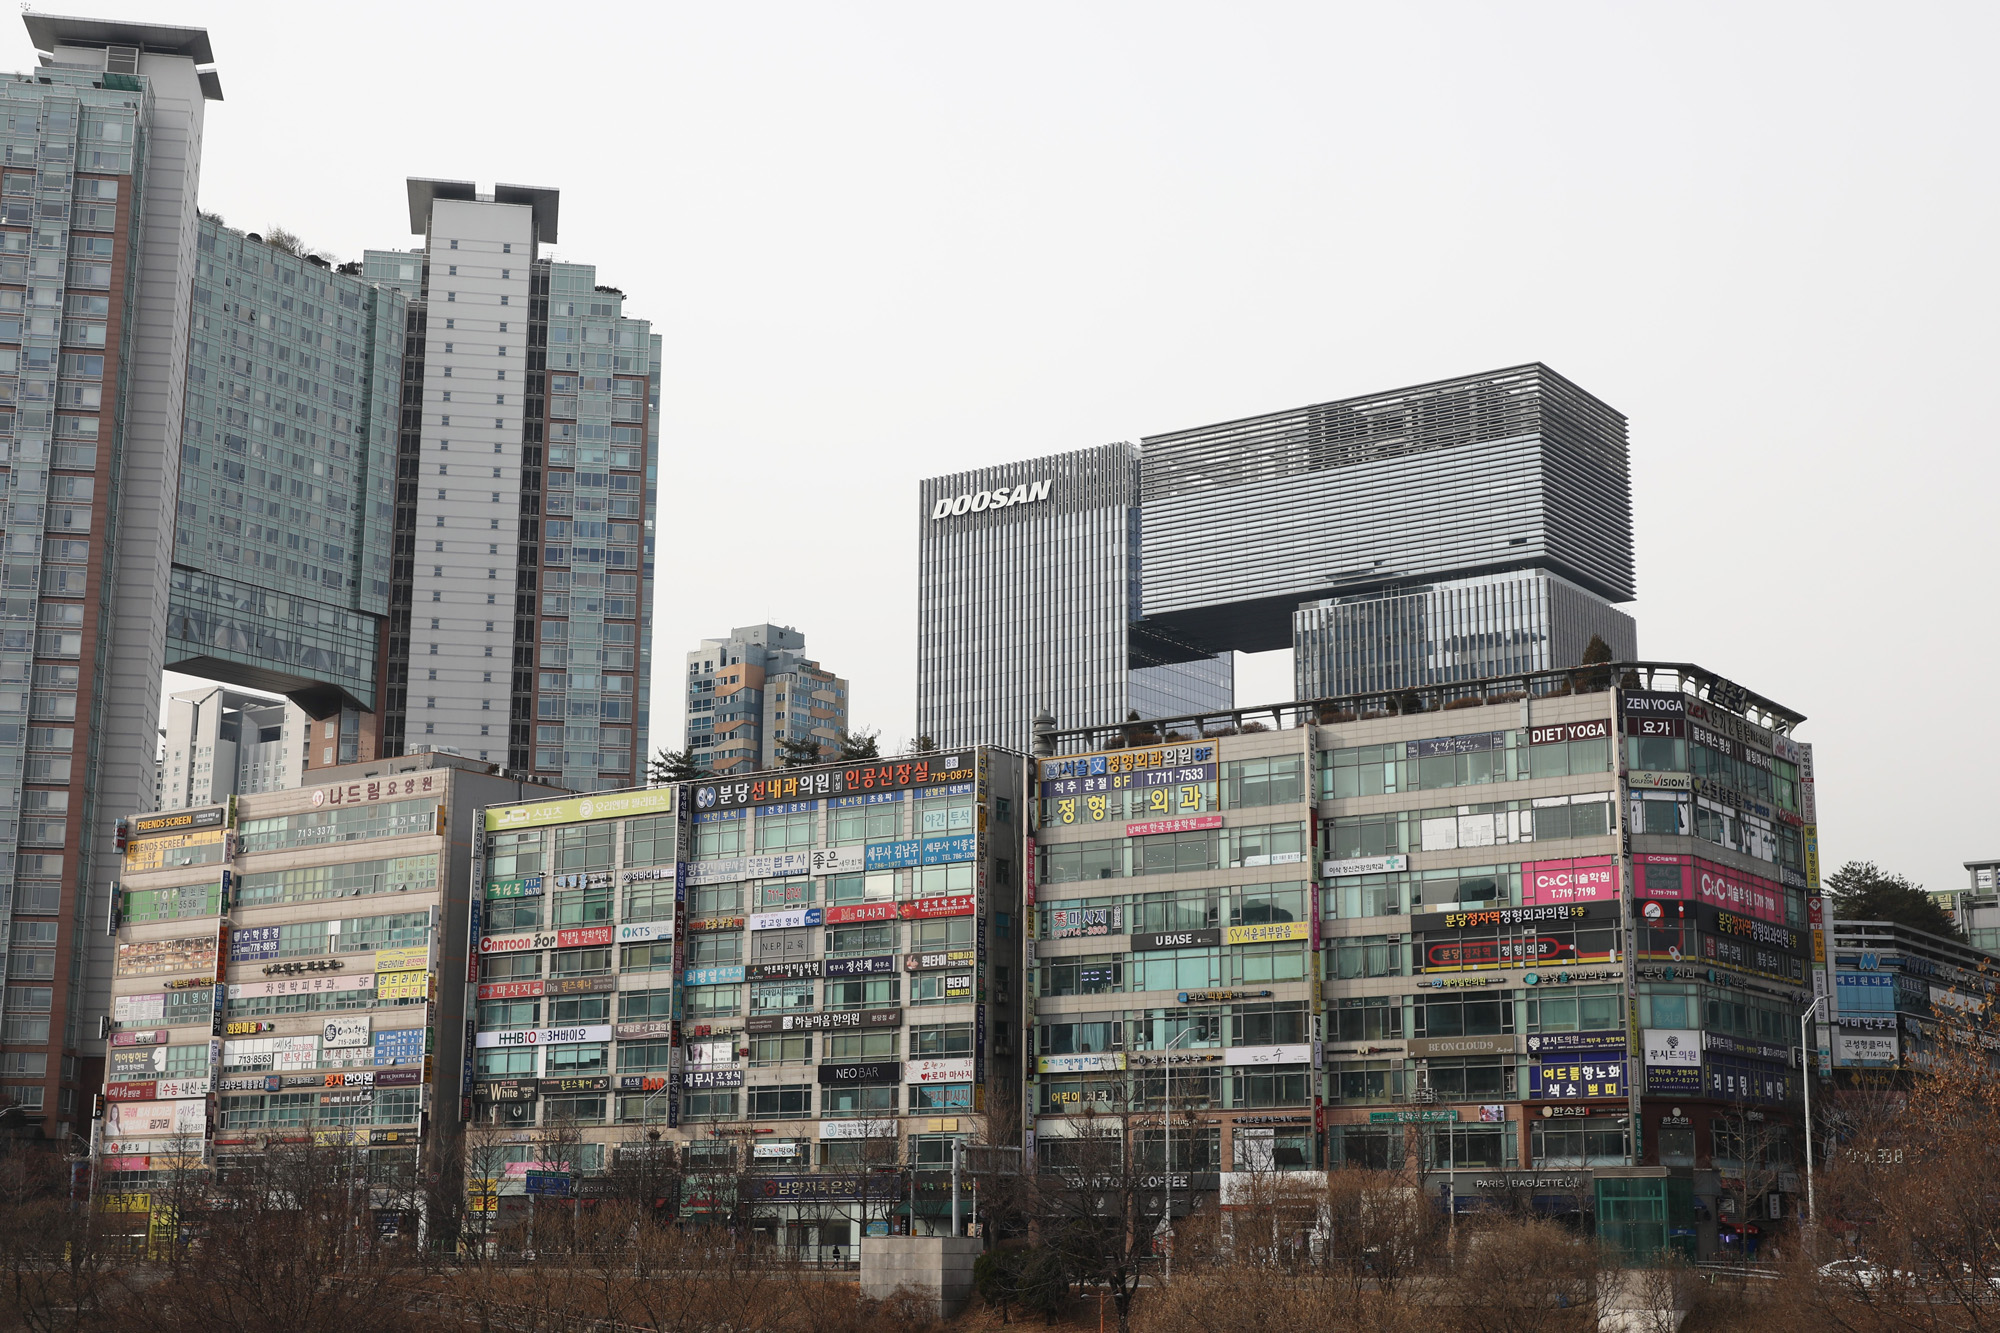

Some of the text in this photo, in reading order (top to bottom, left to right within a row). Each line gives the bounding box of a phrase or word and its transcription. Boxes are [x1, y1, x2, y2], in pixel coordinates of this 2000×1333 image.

[932, 479, 1051, 520] DOOSAN
[1627, 697, 1684, 711] ZEN YOGA
[1532, 723, 1606, 744] DIET YOGA
[1643, 721, 1671, 736] 요가
[1061, 745, 1212, 777] 서울 文 정형외과의원 8F
[718, 761, 974, 804] 분당선내과의원 인공신장실 719-0875
[1055, 777, 1107, 794] 척추 관절
[1113, 768, 1204, 789] 8F T.711-7533
[1653, 774, 1685, 788] VISION
[330, 776, 433, 806] 나드림요양원
[949, 783, 972, 794] 내분비
[631, 794, 667, 809] 필라테스
[767, 802, 807, 814] 건강 검진
[1057, 784, 1202, 824] 정형외과
[533, 806, 564, 820] 스포츠
[703, 811, 719, 821] 야간
[924, 809, 970, 828] 야간 투석
[137, 819, 166, 831] FRIENDS
[165, 815, 193, 827] SCREEN
[389, 816, 428, 829] 재가복지
[1148, 818, 1197, 835] 한국무용학원
[297, 826, 336, 839] 713-3377
[130, 839, 186, 854] FRIENDS SCREEN
[866, 841, 920, 863] 세무사 김남주
[925, 841, 950, 854] 세무사
[774, 853, 806, 869] 법무사
[813, 851, 839, 871] 좋은
[693, 874, 739, 886] 711-9964
[1537, 871, 1610, 888] C&C미술학원
[1702, 873, 1726, 900] C&C
[154, 888, 179, 902] TOP
[525, 887, 541, 897] 5670
[1551, 887, 1597, 900] T.719-7198
[857, 906, 886, 920] 마사지
[1068, 909, 1106, 926] 마사지
[1445, 905, 1586, 928] 분당정자역정형외과의원 5층
[242, 927, 280, 941] 수학풍경
[631, 927, 651, 942] KTS
[1718, 912, 1790, 949] 분당정자역정형외과의원
[480, 933, 556, 954] CARTOON POP
[786, 938, 804, 951] 교육
[1442, 947, 1460, 960] 분당
[1500, 941, 1549, 957] 정형외과
[846, 959, 873, 973] 정선채
[922, 953, 947, 968] 원타이
[265, 976, 370, 995] 차앤박피부과 5F
[547, 979, 592, 993] Dia 퀸즈헤나
[946, 976, 970, 989] 원타이
[496, 983, 531, 998] 마사지
[1207, 990, 1232, 1002] 피부과
[227, 1021, 257, 1034] 회화미술
[794, 1012, 861, 1028] 하늘마음 한의원
[547, 1028, 587, 1043] 3H바이오
[1542, 1035, 1580, 1046] 루시드의원
[1428, 1043, 1440, 1051] BE
[1441, 1042, 1454, 1052] ON
[1455, 1041, 1486, 1051] CLOUD
[1844, 1039, 1892, 1051] 코성형클리닉
[283, 1050, 313, 1063] 분당관
[1204, 1054, 1214, 1062] 3F
[1649, 1049, 1697, 1062] 루시드의원
[684, 1072, 715, 1087] 세무사
[835, 1065, 879, 1079] NEO BAR
[948, 1068, 973, 1081] 마사지
[1543, 1063, 1621, 1081] 여드름 항노화
[1655, 1067, 1699, 1077] 피부과 성형외과
[325, 1071, 374, 1089] 정자한의원
[642, 1077, 665, 1092] BAR
[1649, 1076, 1699, 1084] 031-697-8279
[490, 1083, 518, 1101] White
[1549, 1080, 1617, 1097] 색소 쁘띠
[1051, 1090, 1108, 1105] 어린이 치과
[1552, 1106, 1586, 1117] 한소헌
[1476, 1178, 1564, 1189] PARIS BAGUETTE
